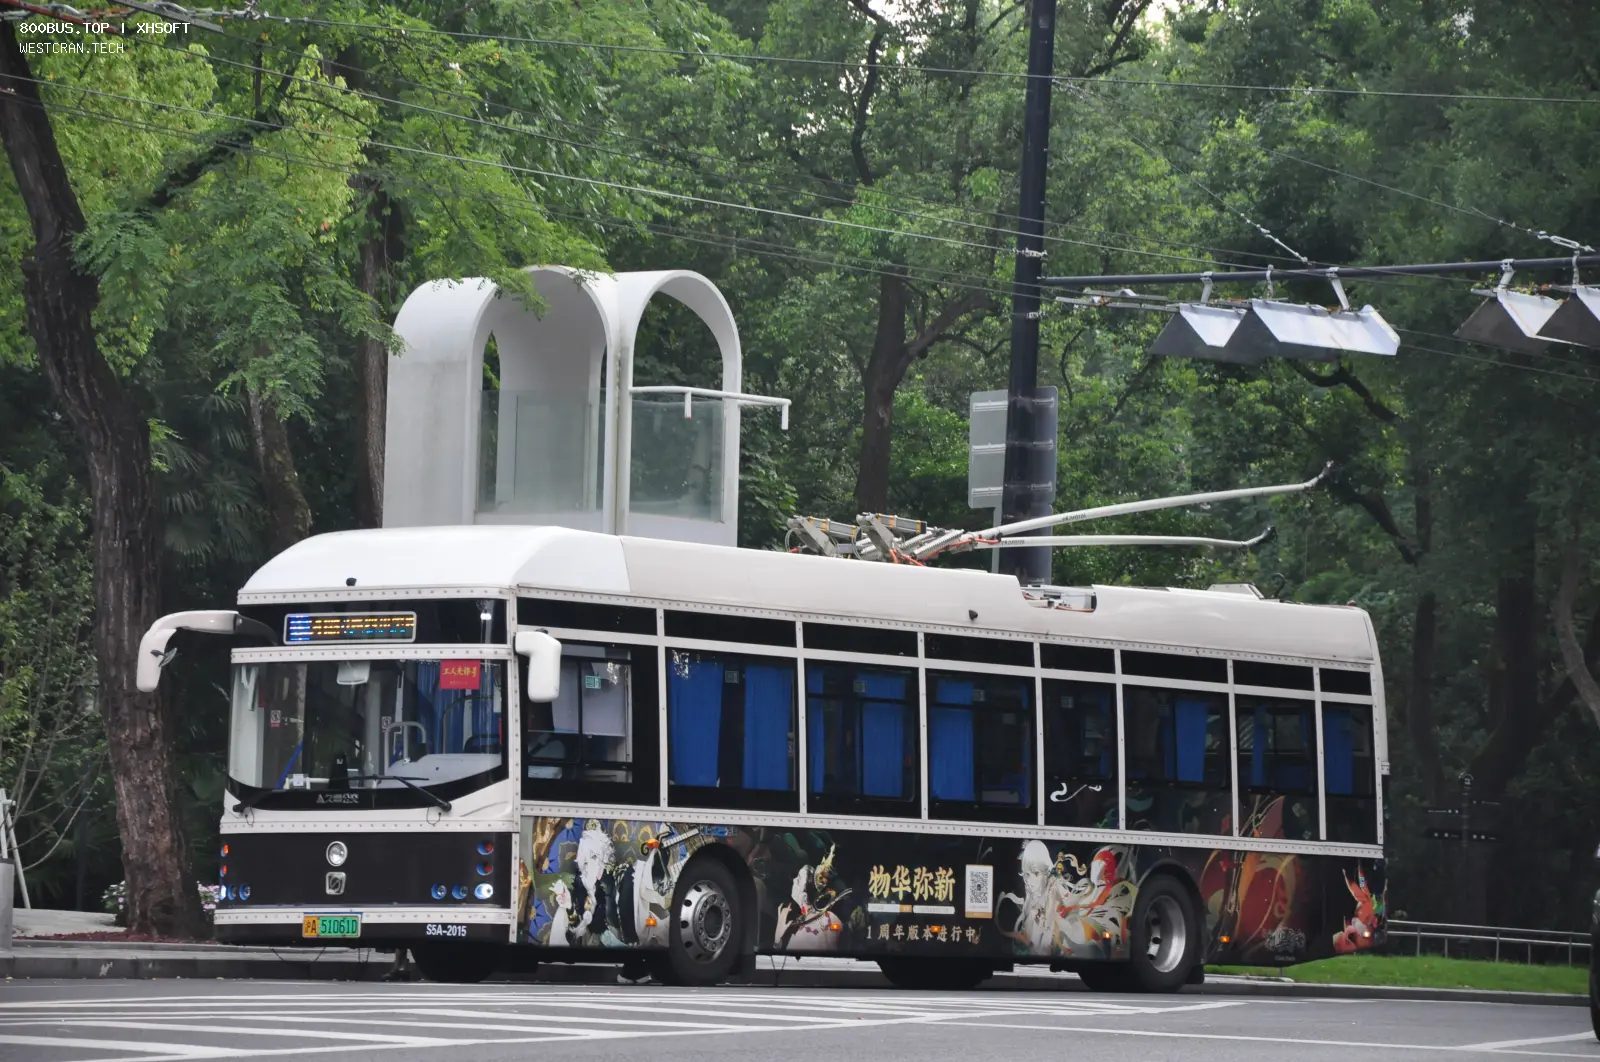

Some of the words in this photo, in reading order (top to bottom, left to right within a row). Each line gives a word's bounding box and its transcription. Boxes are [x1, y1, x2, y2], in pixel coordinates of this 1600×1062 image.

[868, 864, 956, 902] 物华弥新
[320, 919, 358, 934] 51061D
[426, 923, 467, 937] S5A-2015
